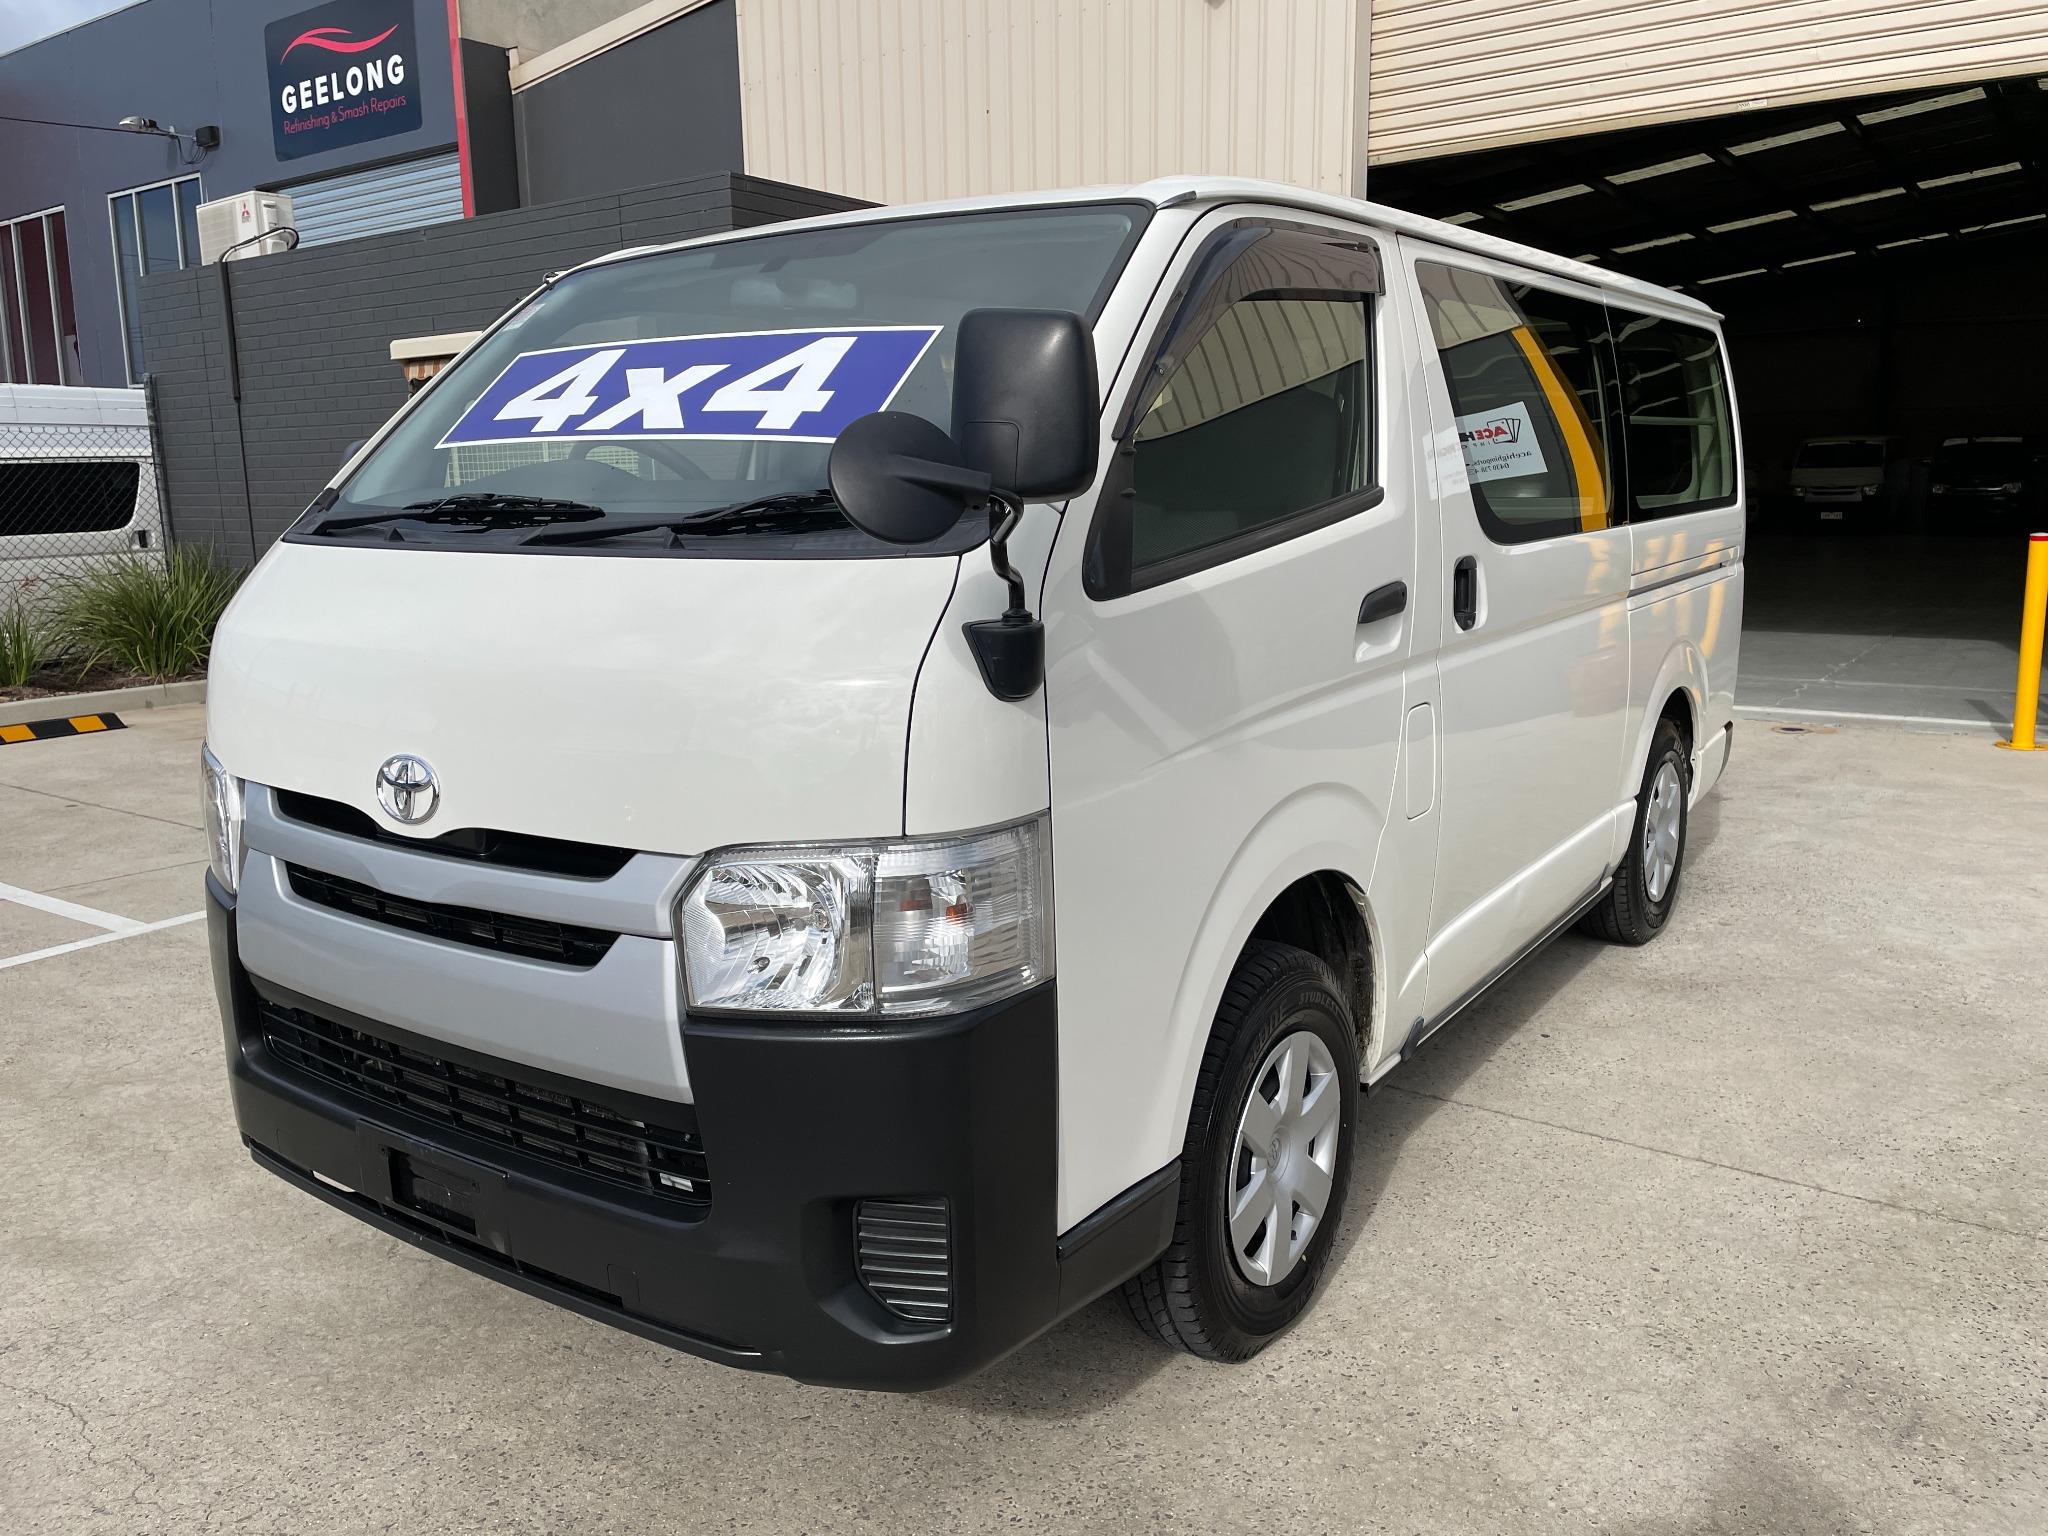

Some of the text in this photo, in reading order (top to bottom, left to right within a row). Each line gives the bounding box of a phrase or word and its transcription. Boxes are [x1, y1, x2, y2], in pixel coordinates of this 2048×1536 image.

[282, 54, 405, 114] GEELONG
[284, 95, 406, 134] Refinishing & Smash Repairs
[492, 336, 858, 433] 4x4
